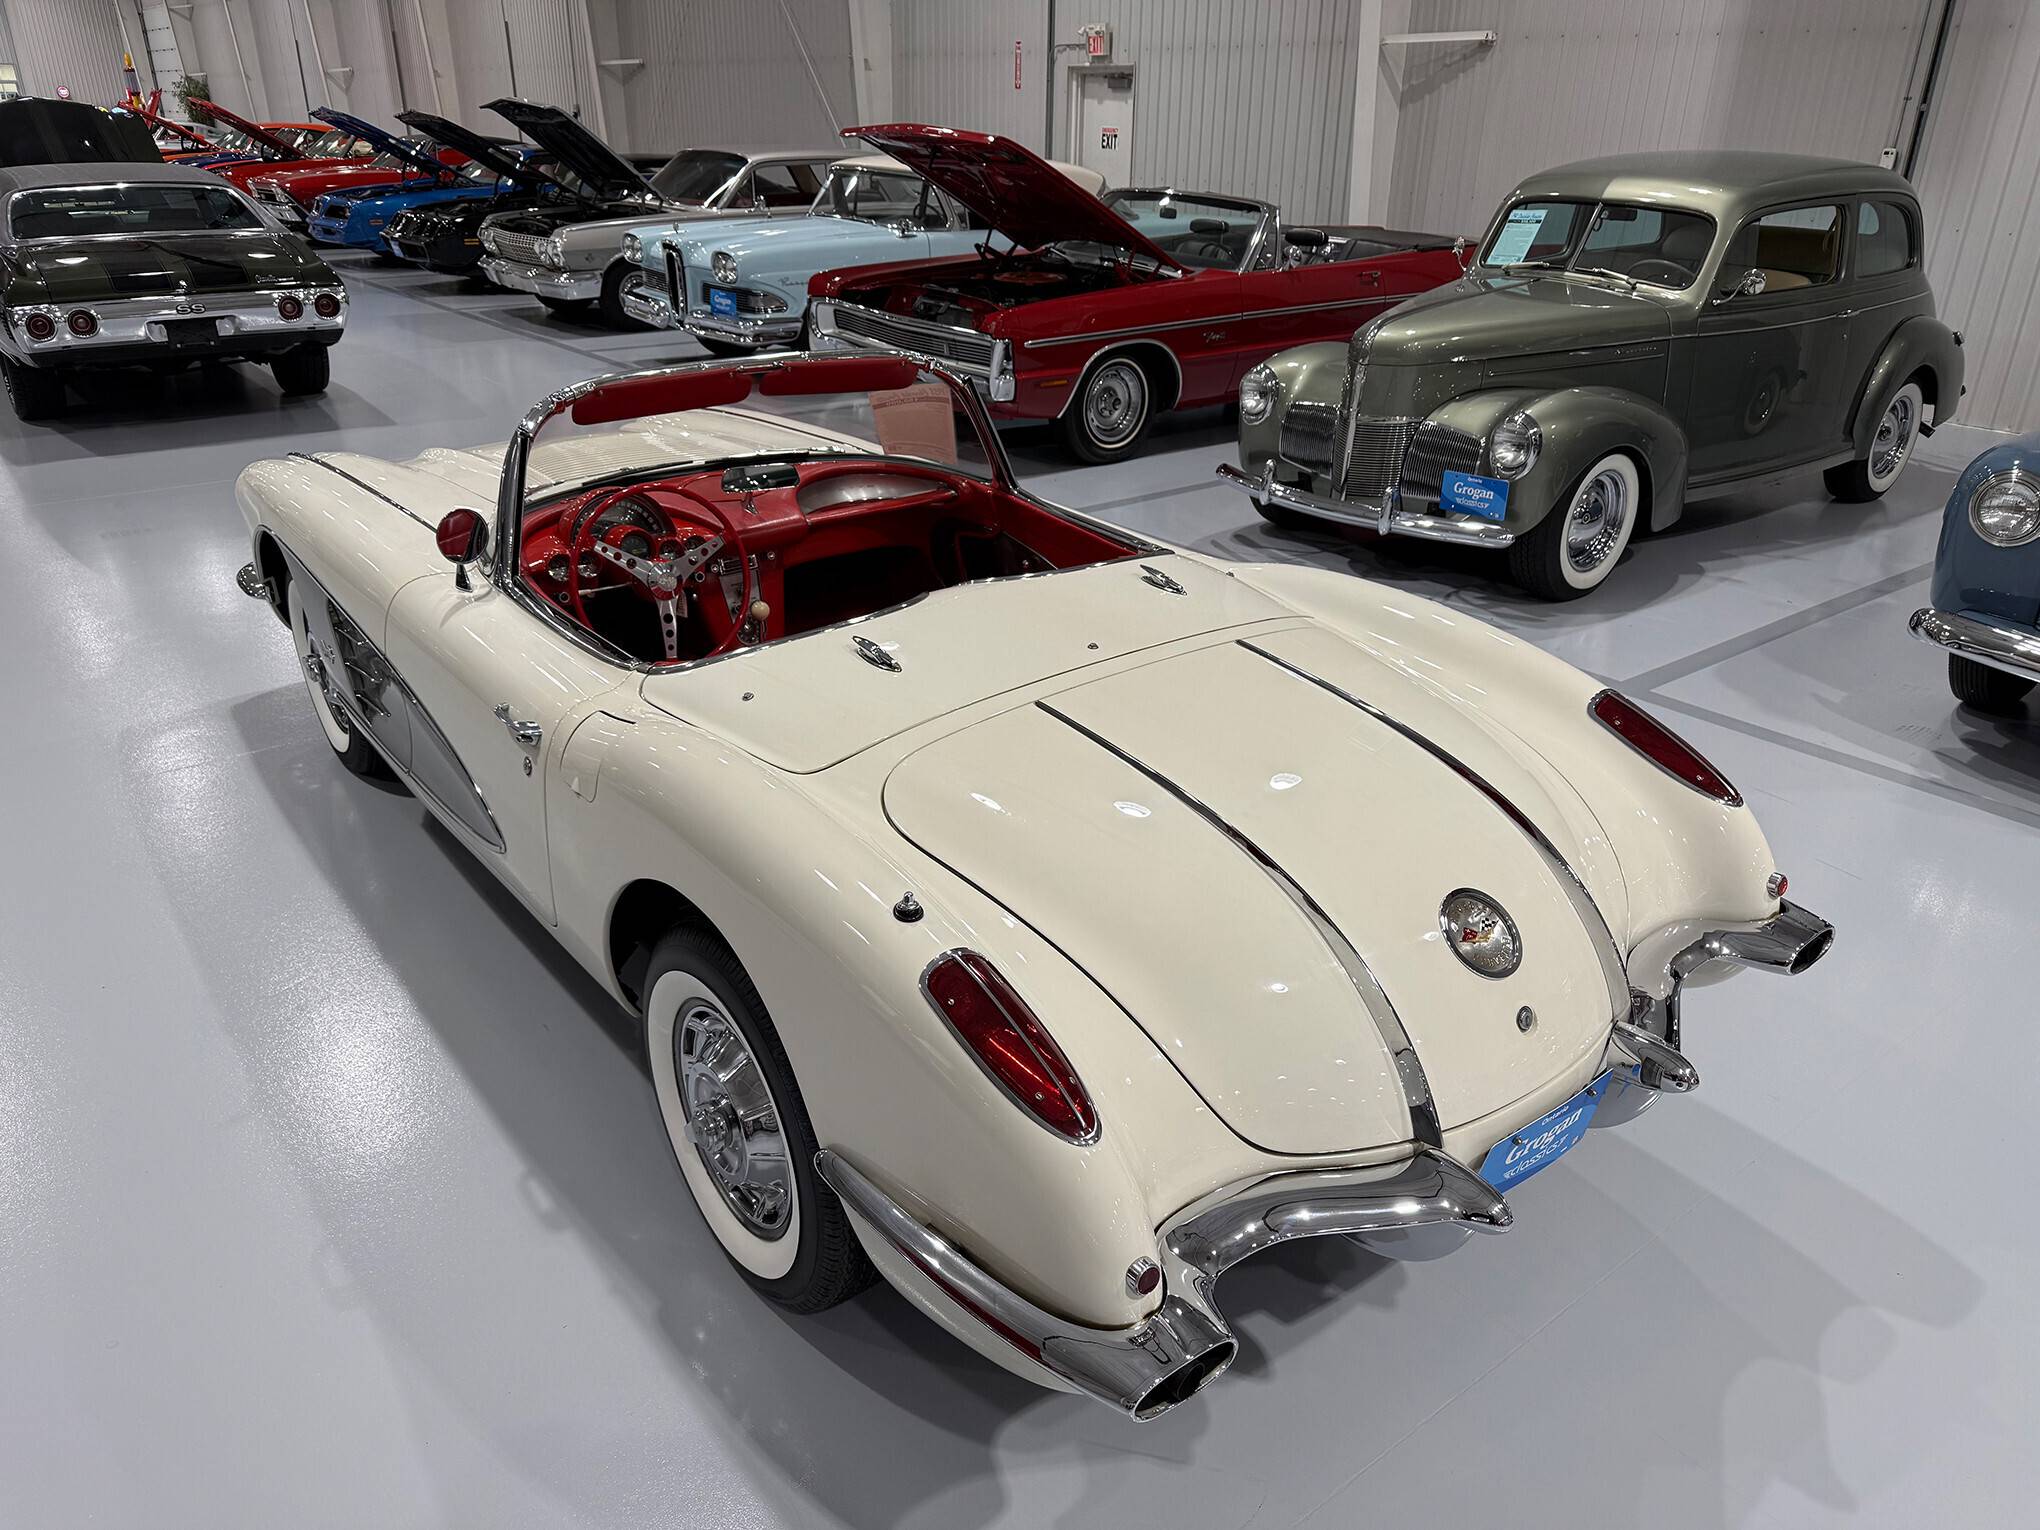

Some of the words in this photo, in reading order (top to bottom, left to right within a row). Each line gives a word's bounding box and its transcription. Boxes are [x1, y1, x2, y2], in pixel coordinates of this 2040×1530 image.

[1089, 37, 1104, 53] EXIT
[1101, 133, 1118, 150] EXIT
[176, 302, 206, 315] SS
[1454, 481, 1494, 500] Grogan
[1541, 1105, 1569, 1126] Ontario
[1505, 1108, 1583, 1165] Grogan
